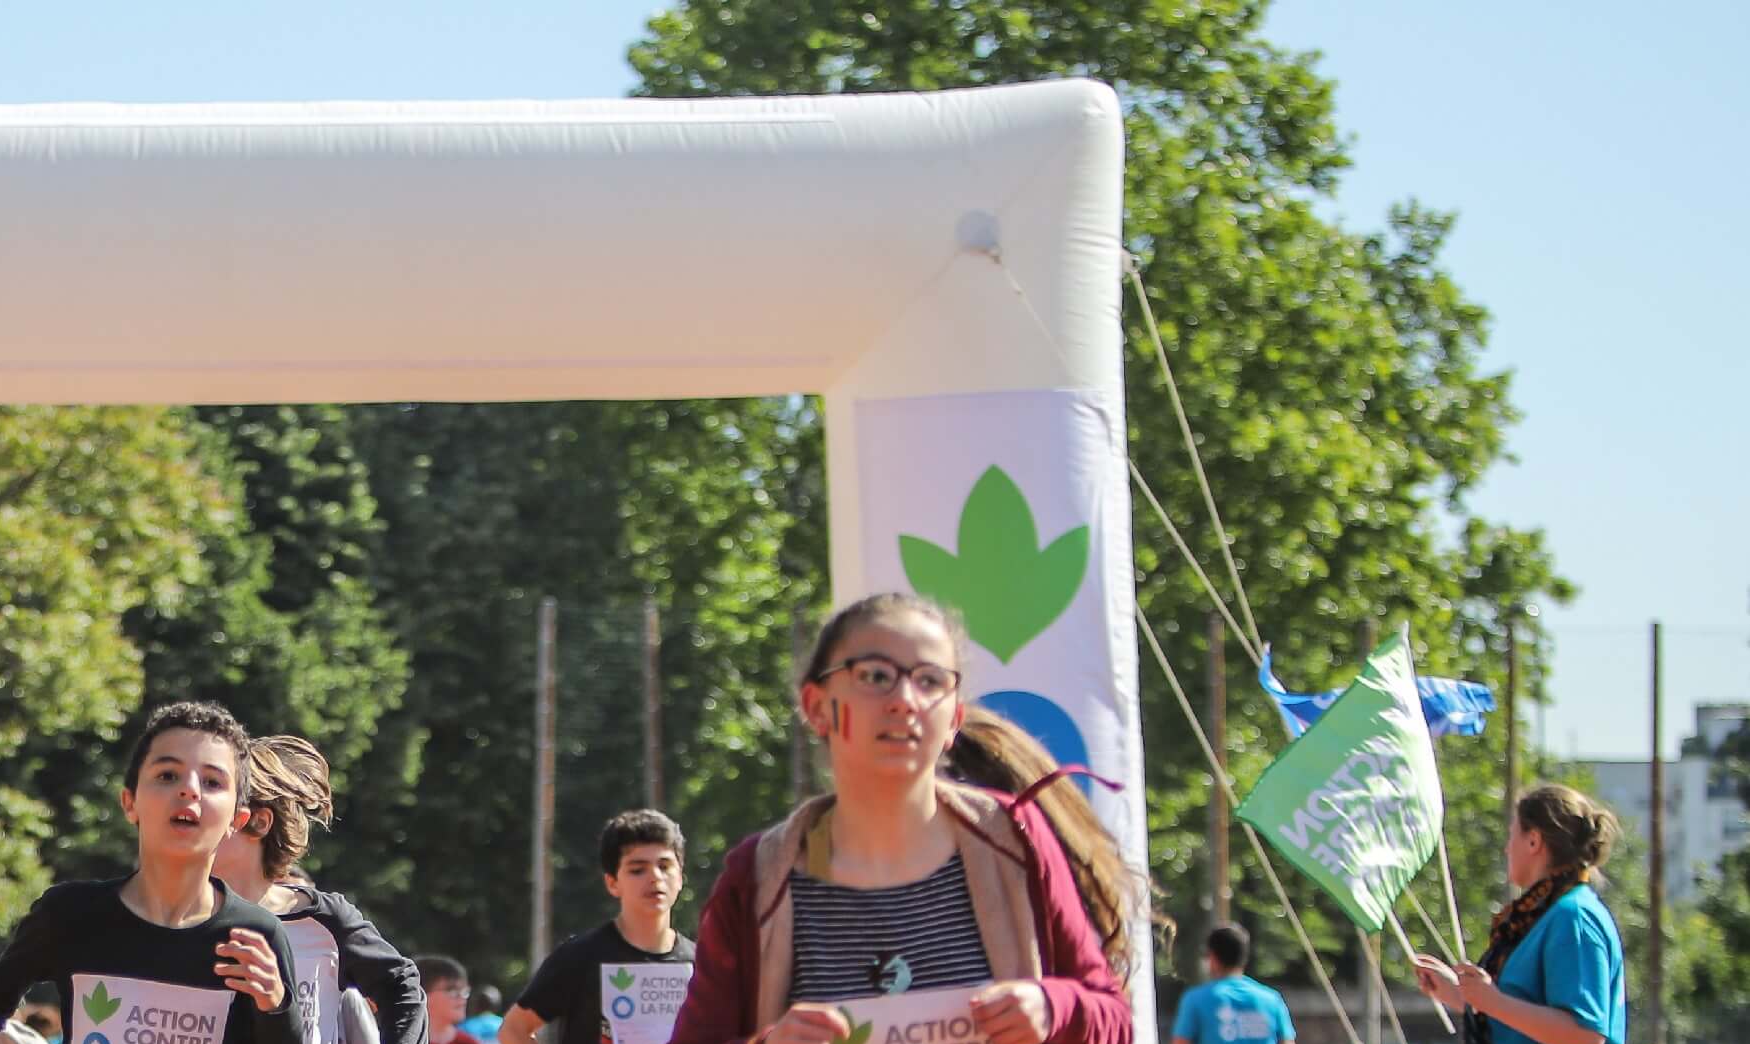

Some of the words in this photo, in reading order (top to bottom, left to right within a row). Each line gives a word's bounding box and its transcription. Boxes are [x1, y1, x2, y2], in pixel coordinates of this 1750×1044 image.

[641, 1003, 657, 1015] LA
[659, 1003, 678, 1015] FAI
[126, 1005, 217, 1034] ACTION
